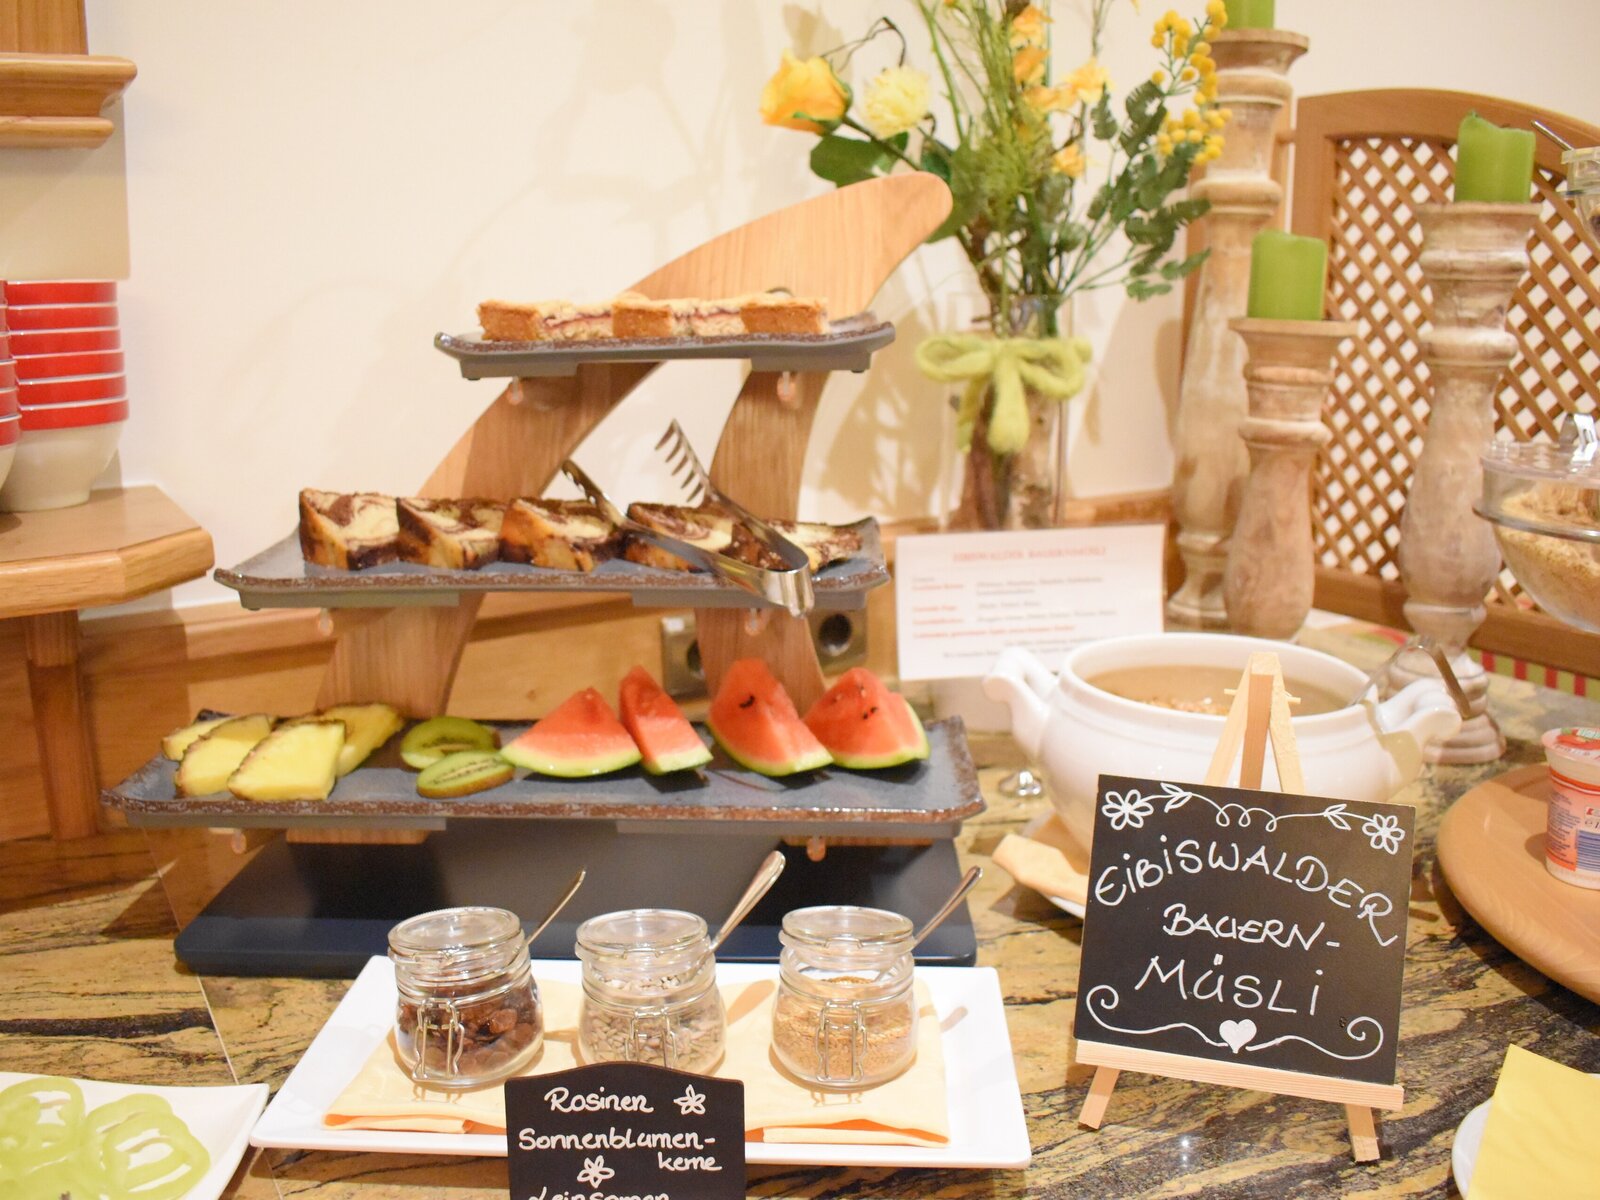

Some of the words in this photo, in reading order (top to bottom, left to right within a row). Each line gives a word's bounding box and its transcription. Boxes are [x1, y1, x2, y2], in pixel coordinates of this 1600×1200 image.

[1162, 902, 1341, 951] BAUERN-
[543, 1085, 655, 1114] Rosinen
[517, 1126, 717, 1151] Sonnenblumen-
[656, 1151, 723, 1172] kerne
